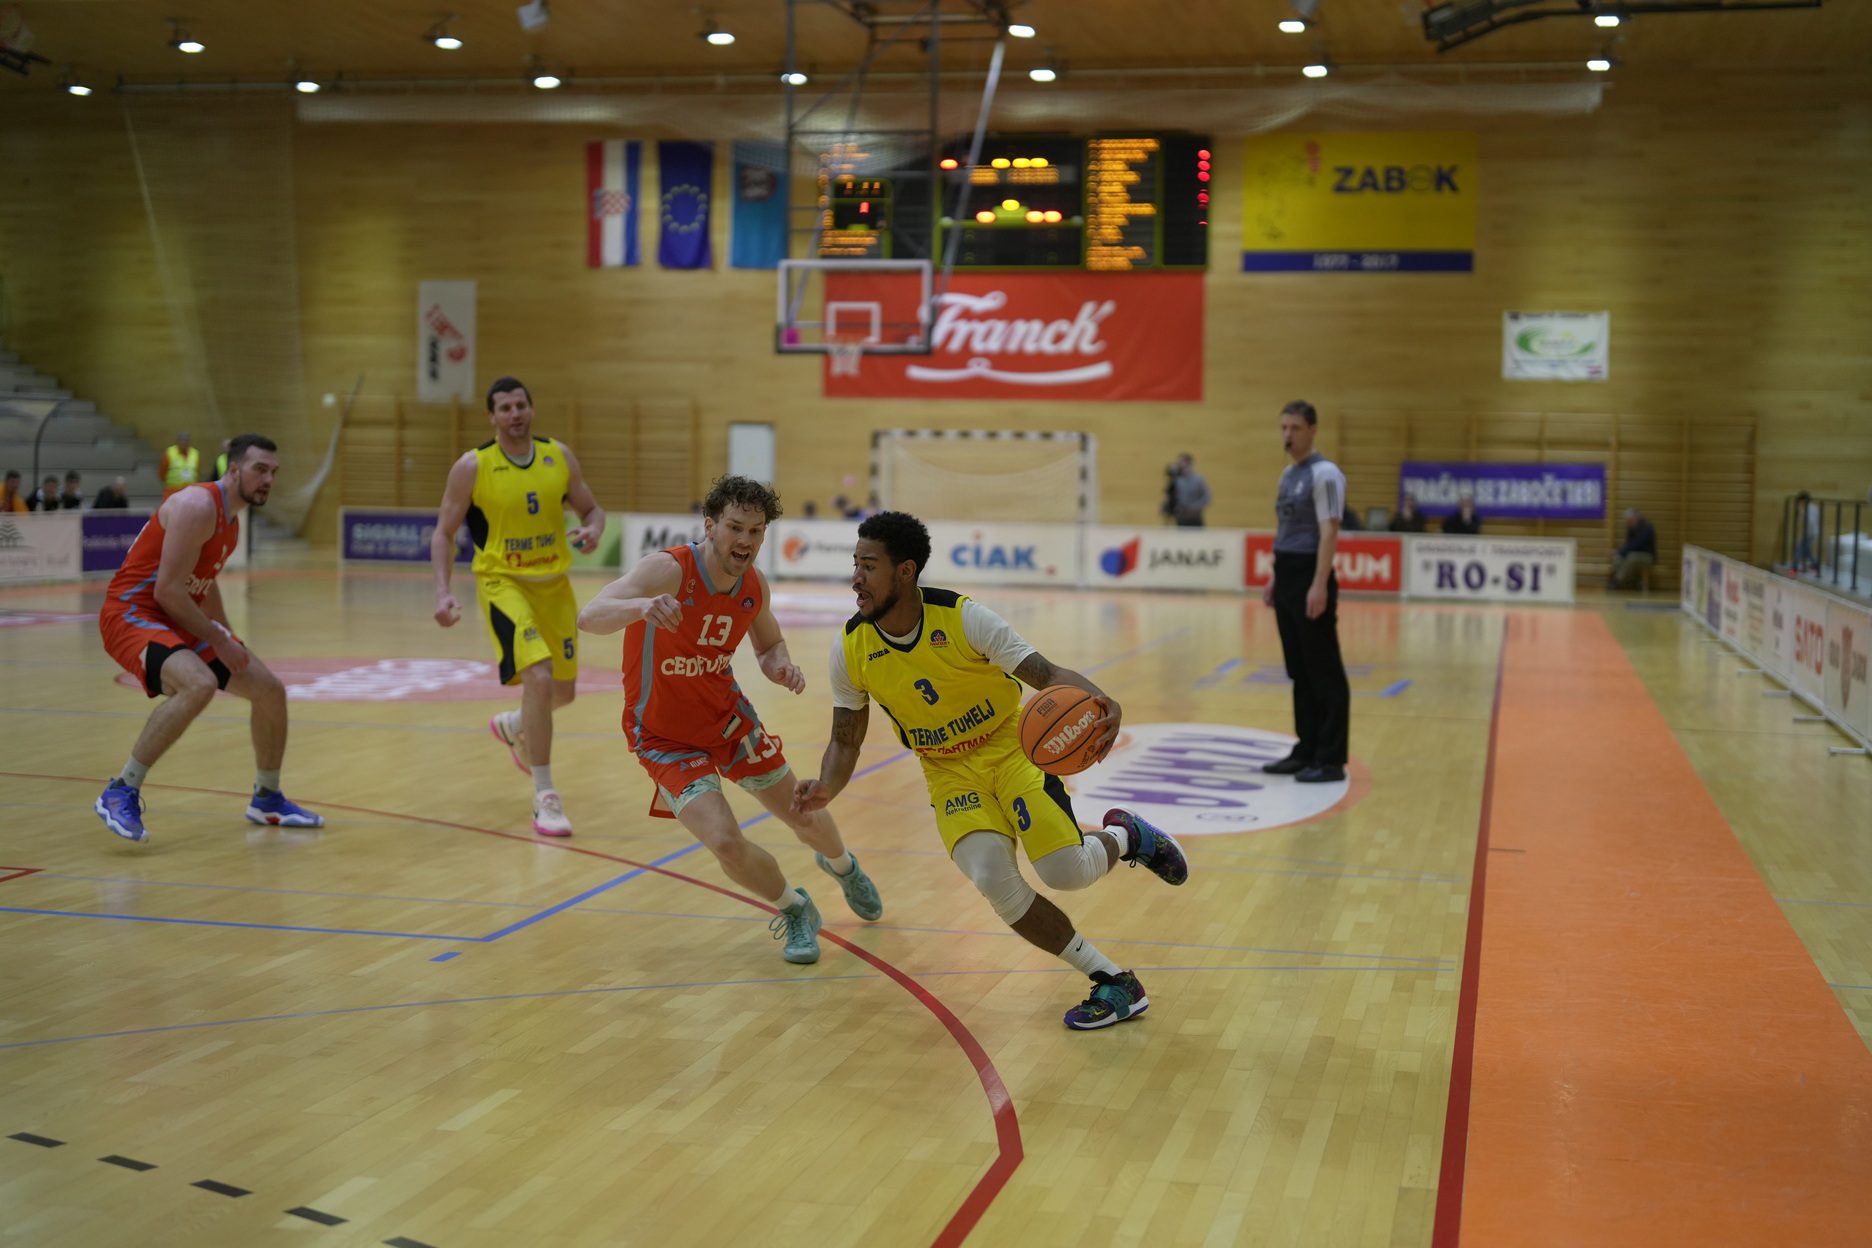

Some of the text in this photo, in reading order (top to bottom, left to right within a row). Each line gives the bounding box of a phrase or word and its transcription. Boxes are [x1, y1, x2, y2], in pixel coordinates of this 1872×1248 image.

[922, 290, 1115, 356] Franck
[526, 491, 539, 514] 5
[505, 537, 533, 551] TERME
[1148, 548, 1227, 569] JANAF
[696, 614, 733, 646] 13
[563, 638, 575, 659] 5
[914, 678, 940, 706] 3
[909, 698, 996, 746] TERME TUHELJ
[1043, 710, 1095, 755] Wilson
[740, 727, 777, 764] 13
[945, 792, 980, 811] AMG
[1012, 796, 1031, 832] 3
